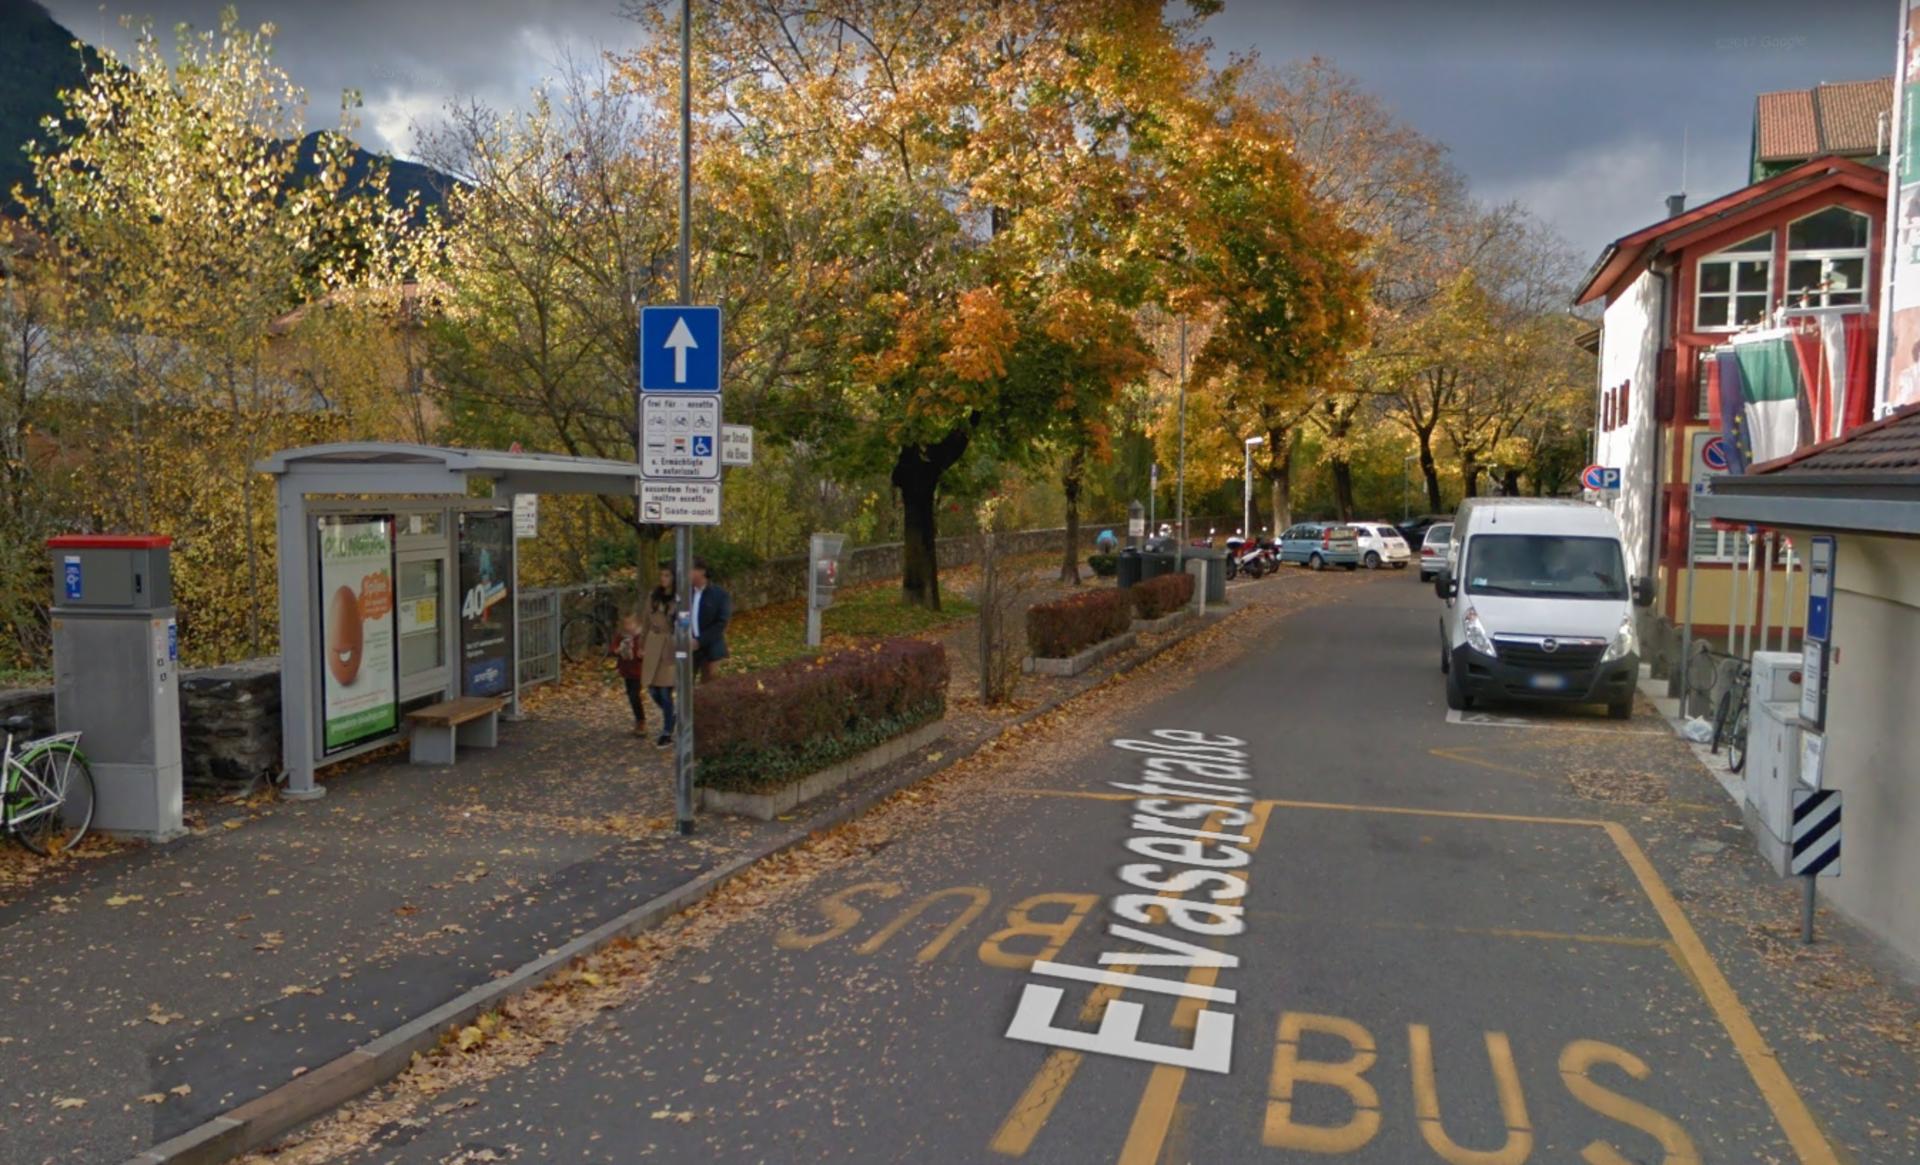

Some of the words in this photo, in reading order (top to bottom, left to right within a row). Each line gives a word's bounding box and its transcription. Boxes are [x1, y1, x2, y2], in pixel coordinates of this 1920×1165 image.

[1602, 470, 1618, 487] P
[462, 584, 485, 620] 40
[775, 881, 1100, 968] BUS
[1262, 1011, 1699, 1165] BUS
